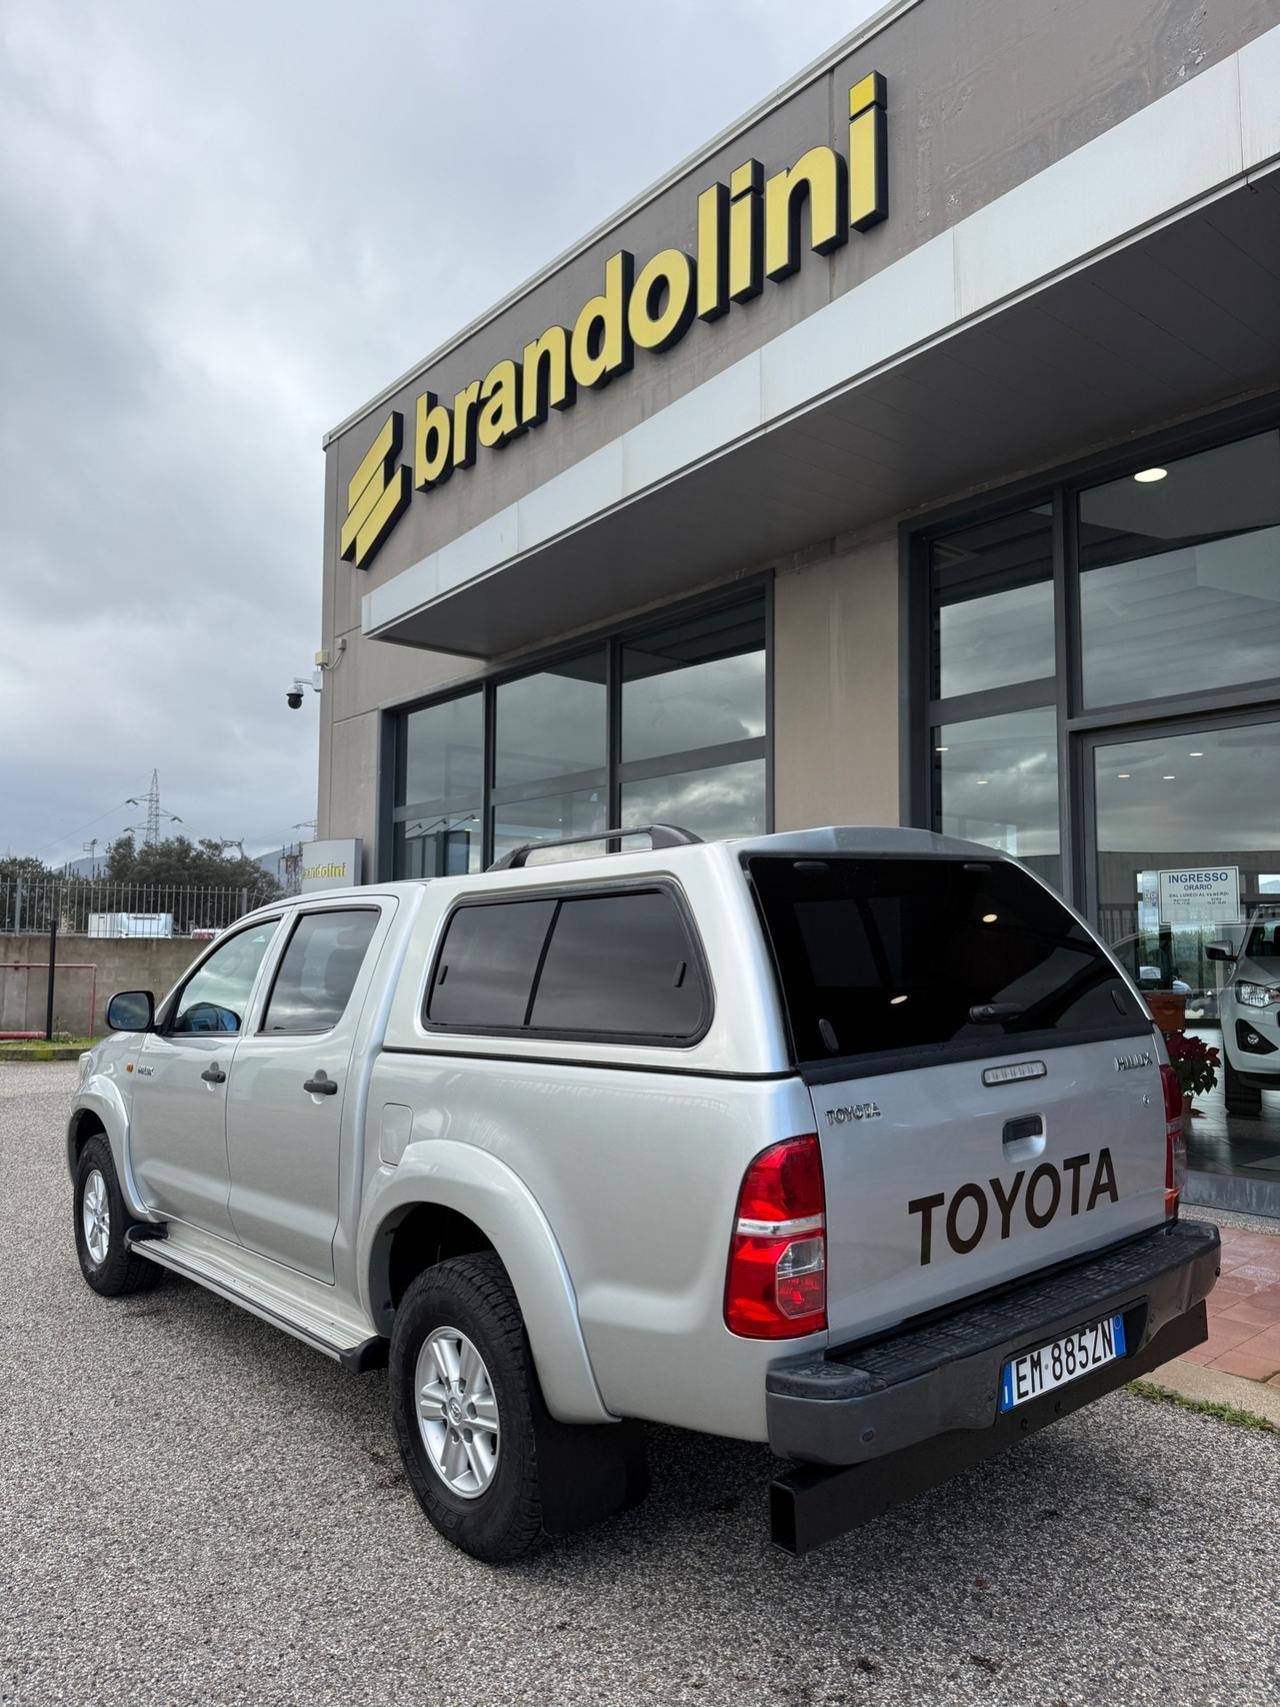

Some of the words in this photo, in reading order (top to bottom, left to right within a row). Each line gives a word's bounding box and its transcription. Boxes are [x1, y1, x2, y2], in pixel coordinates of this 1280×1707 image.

[414, 69, 889, 492] brandolini
[1168, 872, 1228, 884] INGRESSO
[1114, 1052, 1152, 1072] HILUX
[824, 1102, 881, 1126] TOYOTA
[908, 1147, 1119, 1266] TOYOTA
